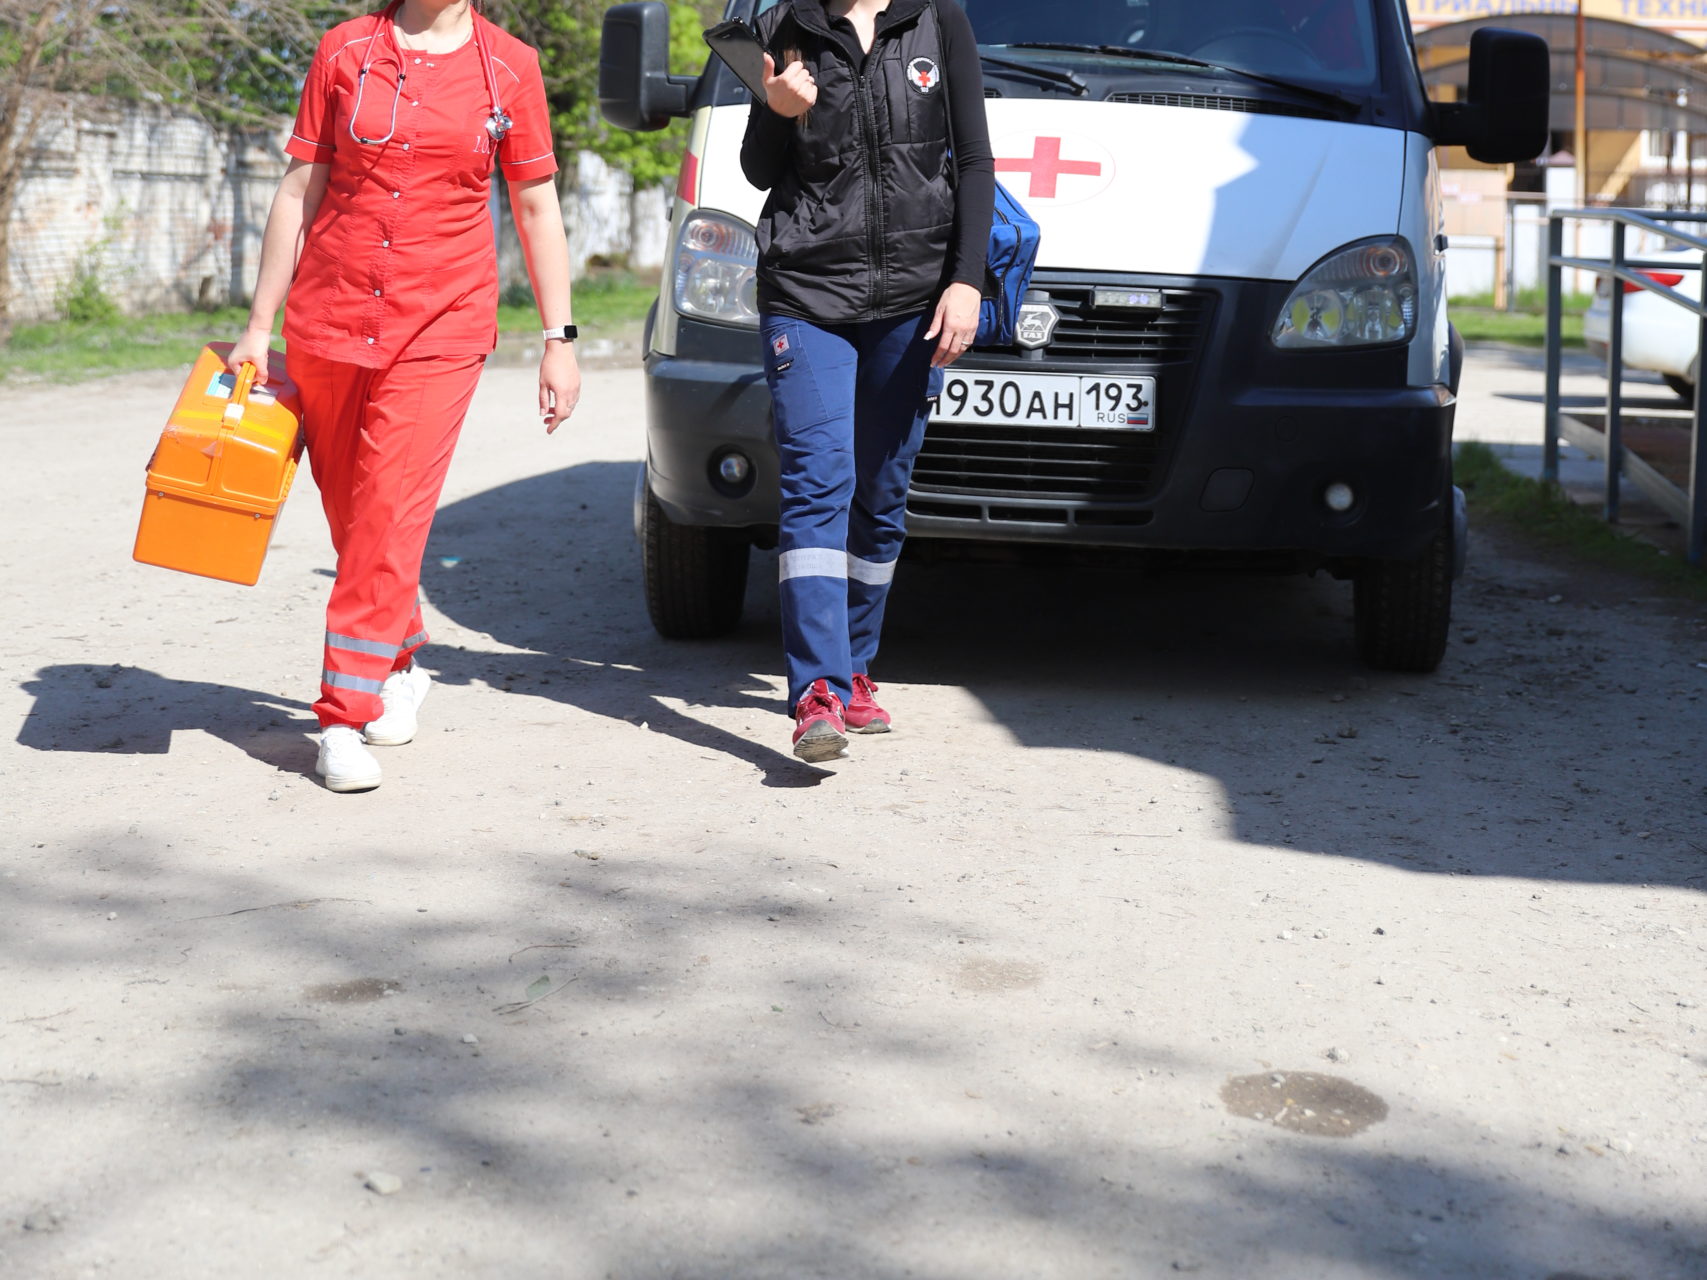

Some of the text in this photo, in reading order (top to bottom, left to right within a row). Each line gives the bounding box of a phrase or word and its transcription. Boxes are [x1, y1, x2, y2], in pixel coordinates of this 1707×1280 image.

[473, 135, 491, 155] 10
[1085, 382, 1144, 412] 193
[1096, 412, 1127, 424] RUS
